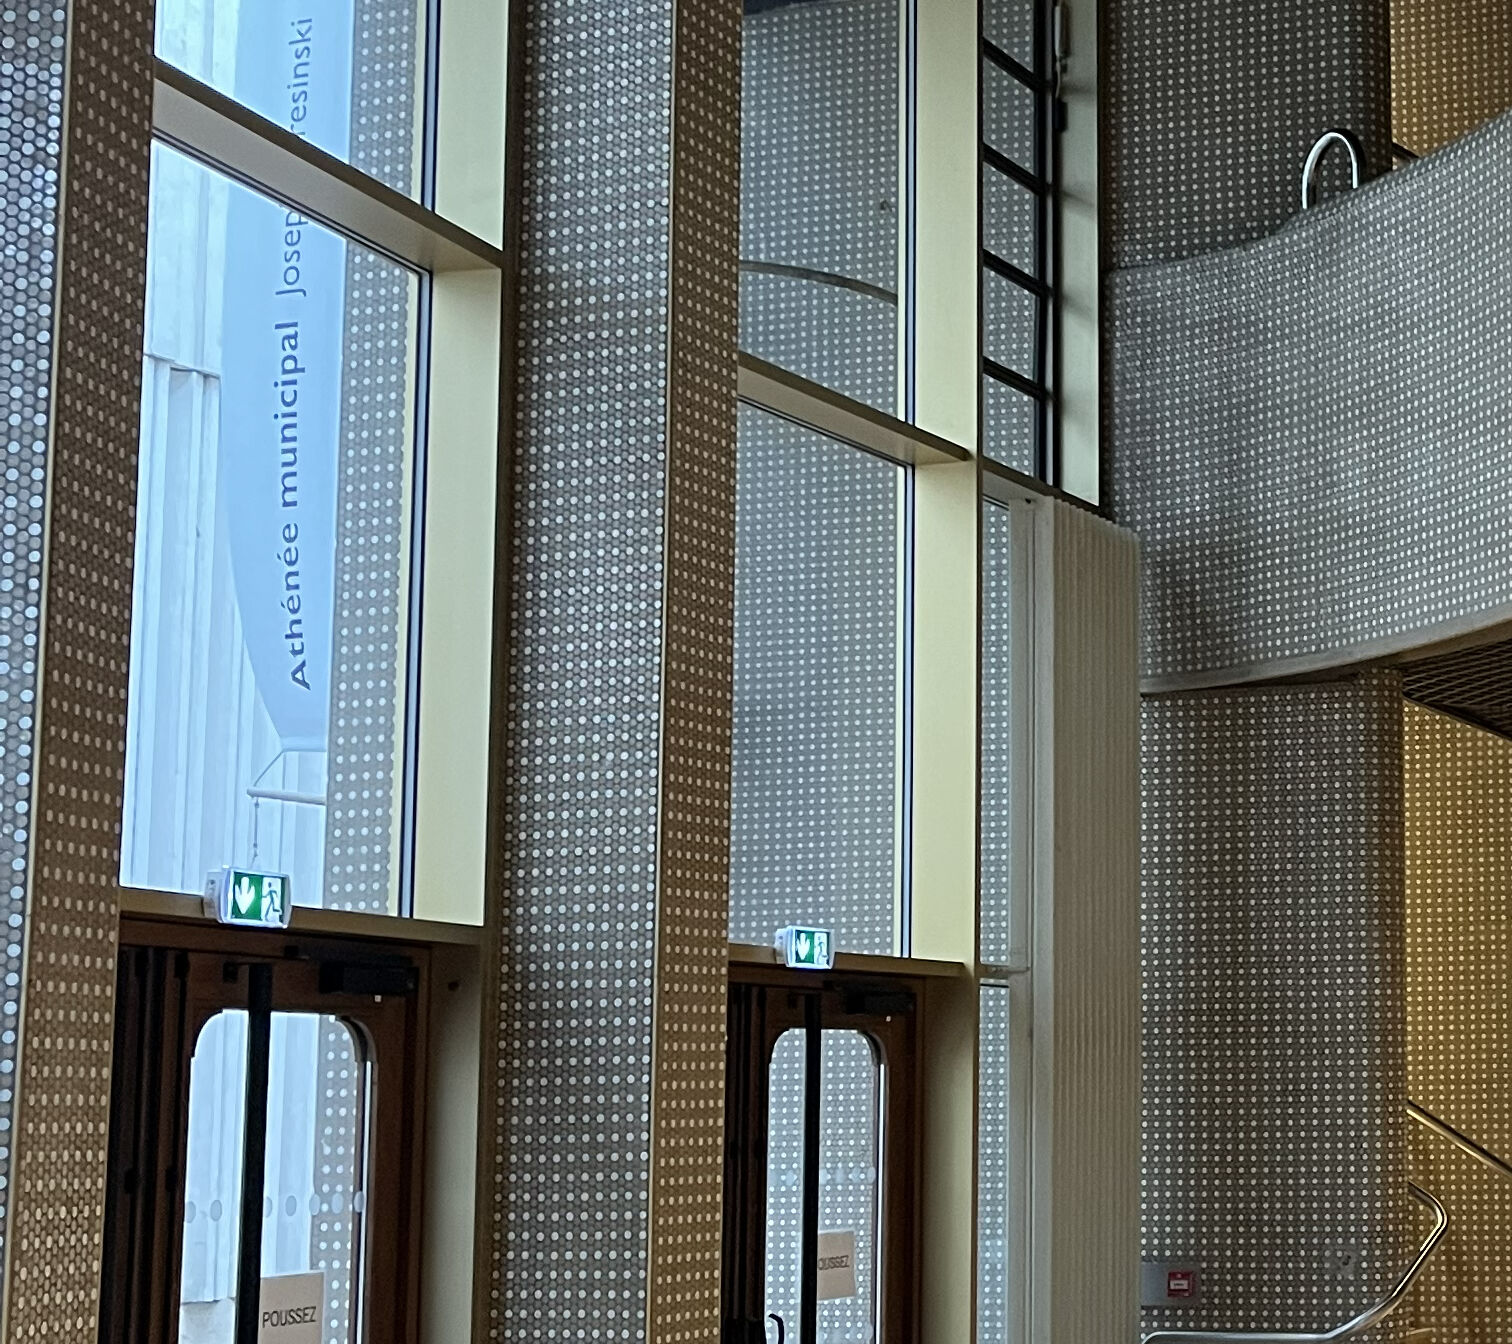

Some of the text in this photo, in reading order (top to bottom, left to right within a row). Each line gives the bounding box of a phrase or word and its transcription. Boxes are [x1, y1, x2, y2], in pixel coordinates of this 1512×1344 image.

[273, 17, 313, 691] Athénée municipal Josep resinski
[818, 1254, 850, 1270] OUSSEZ
[262, 1306, 317, 1329] POUSSEZ
